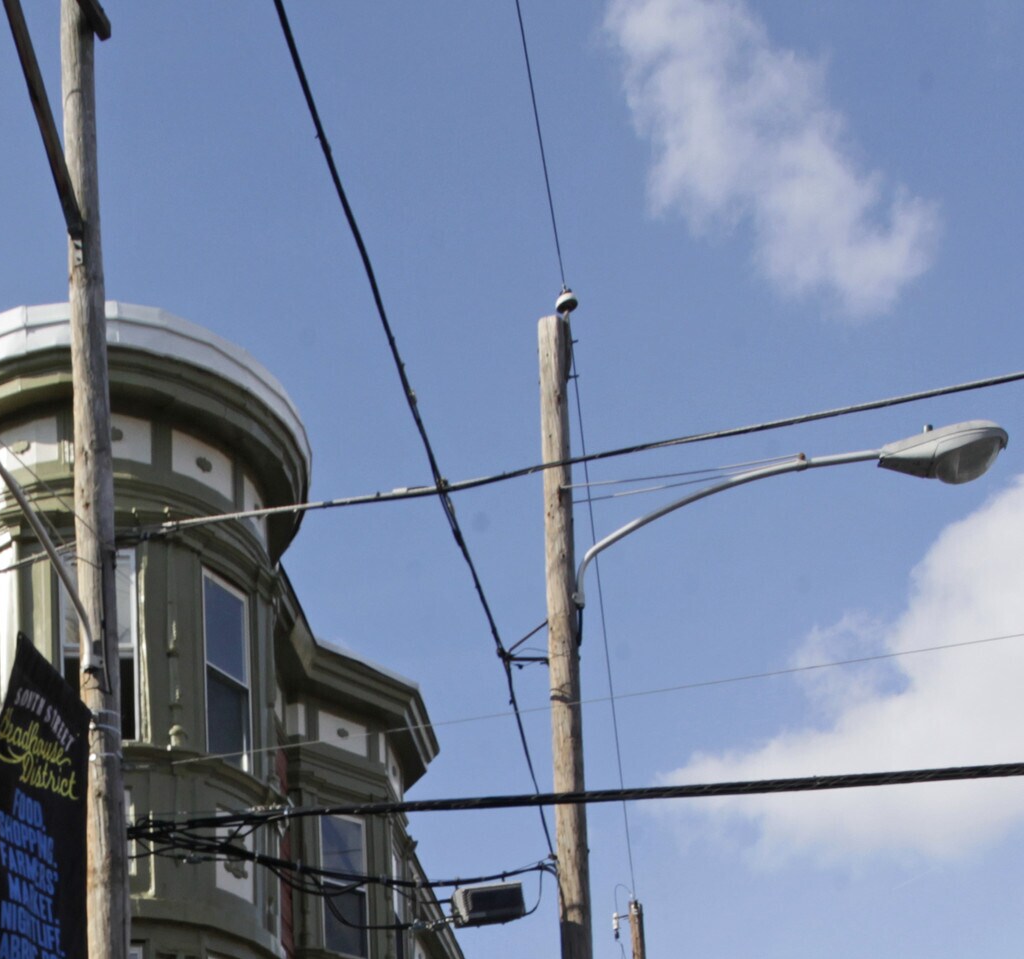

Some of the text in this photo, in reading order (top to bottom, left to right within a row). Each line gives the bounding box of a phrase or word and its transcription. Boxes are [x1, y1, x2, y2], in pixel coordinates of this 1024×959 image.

[14, 688, 75, 751] SOUTH STREET
[20, 753, 79, 801] District
